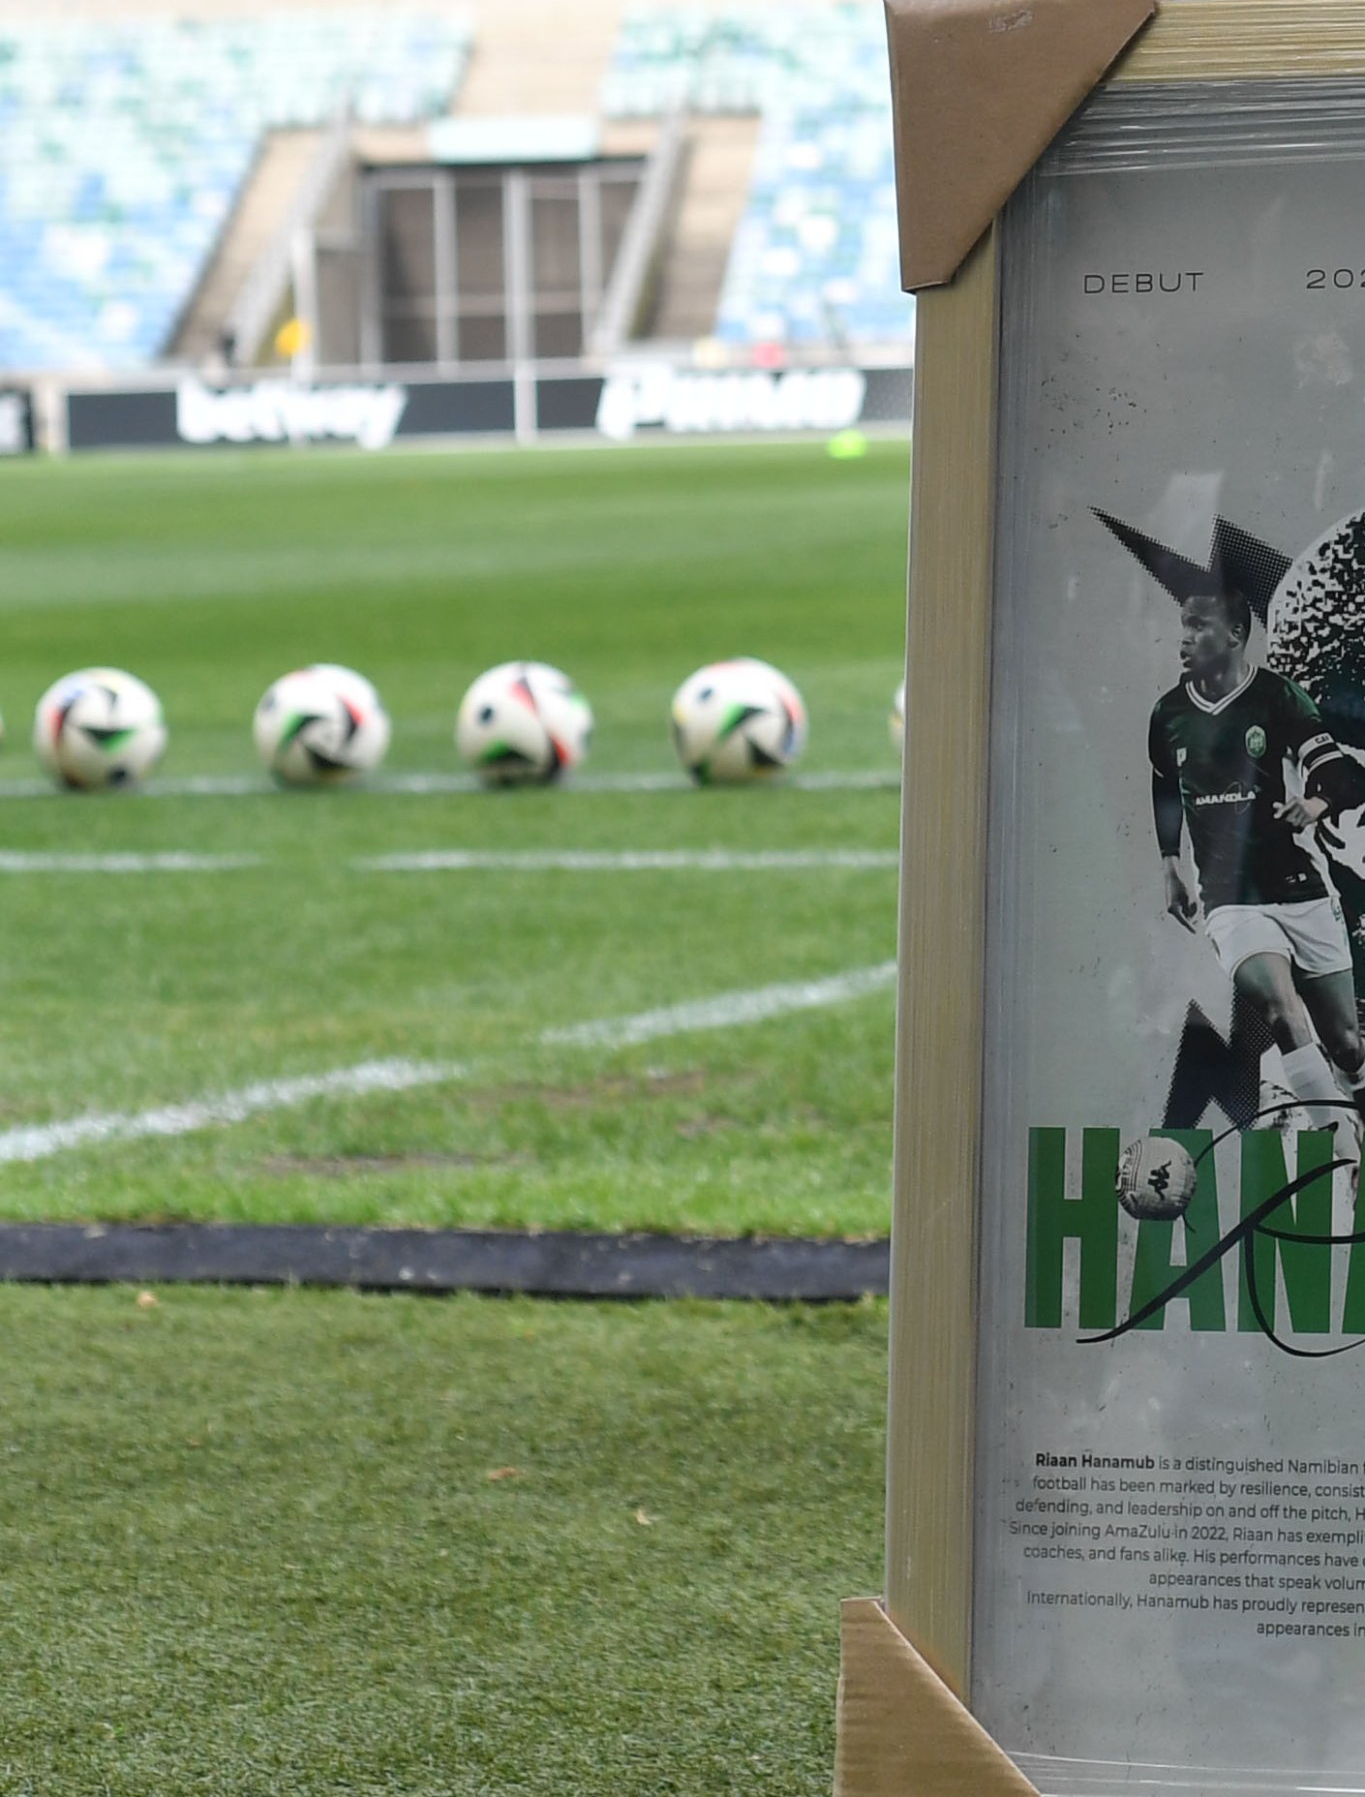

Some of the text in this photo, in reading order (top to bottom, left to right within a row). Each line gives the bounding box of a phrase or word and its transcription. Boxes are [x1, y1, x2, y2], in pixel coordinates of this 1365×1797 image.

[1083, 271, 1204, 295] DEBUT
[1035, 1453, 1078, 1468] Riaan
[1081, 1455, 1156, 1469] Hanamub
[1159, 1456, 1170, 1470] is
[1172, 1460, 1182, 1470] a
[1184, 1457, 1284, 1476] distinguished
[1288, 1459, 1359, 1474] Namibian
[1032, 1476, 1087, 1491] football
[1090, 1478, 1116, 1492] has
[1119, 1478, 1156, 1493] been
[1159, 1479, 1216, 1494] marked
[1218, 1481, 1238, 1498] by
[1240, 1481, 1312, 1498] resilience,
[1015, 1499, 1093, 1517] defending,
[1095, 1501, 1124, 1515] and
[1128, 1502, 1203, 1520] leadership
[1205, 1507, 1227, 1517] on
[1228, 1504, 1256, 1518] and
[1260, 1505, 1280, 1518] off
[1282, 1505, 1308, 1519] the
[1310, 1506, 1352, 1524] pitch,
[1009, 1521, 1048, 1535] Since
[1049, 1522, 1101, 1540] joining
[1104, 1523, 1171, 1538] AmaZulu
[1174, 1525, 1188, 1538] in
[1190, 1526, 1229, 1542] 2022,
[1232, 1527, 1274, 1541] Riaan
[1277, 1528, 1303, 1542] has
[1023, 1544, 1085, 1561] coaches,
[1088, 1546, 1116, 1560] and
[1120, 1547, 1150, 1560] fans
[1193, 1548, 1216, 1562] His
[1218, 1549, 1321, 1568] performances
[1324, 1552, 1360, 1566] have
[1148, 1573, 1242, 1590] appearances
[1244, 1574, 1275, 1588] that
[1278, 1575, 1322, 1593] speak
[1136, 1593, 1210, 1608] Hanamub
[1212, 1595, 1238, 1609] has
[1242, 1596, 1298, 1615] proudly
[1256, 1622, 1350, 1639] appearances
